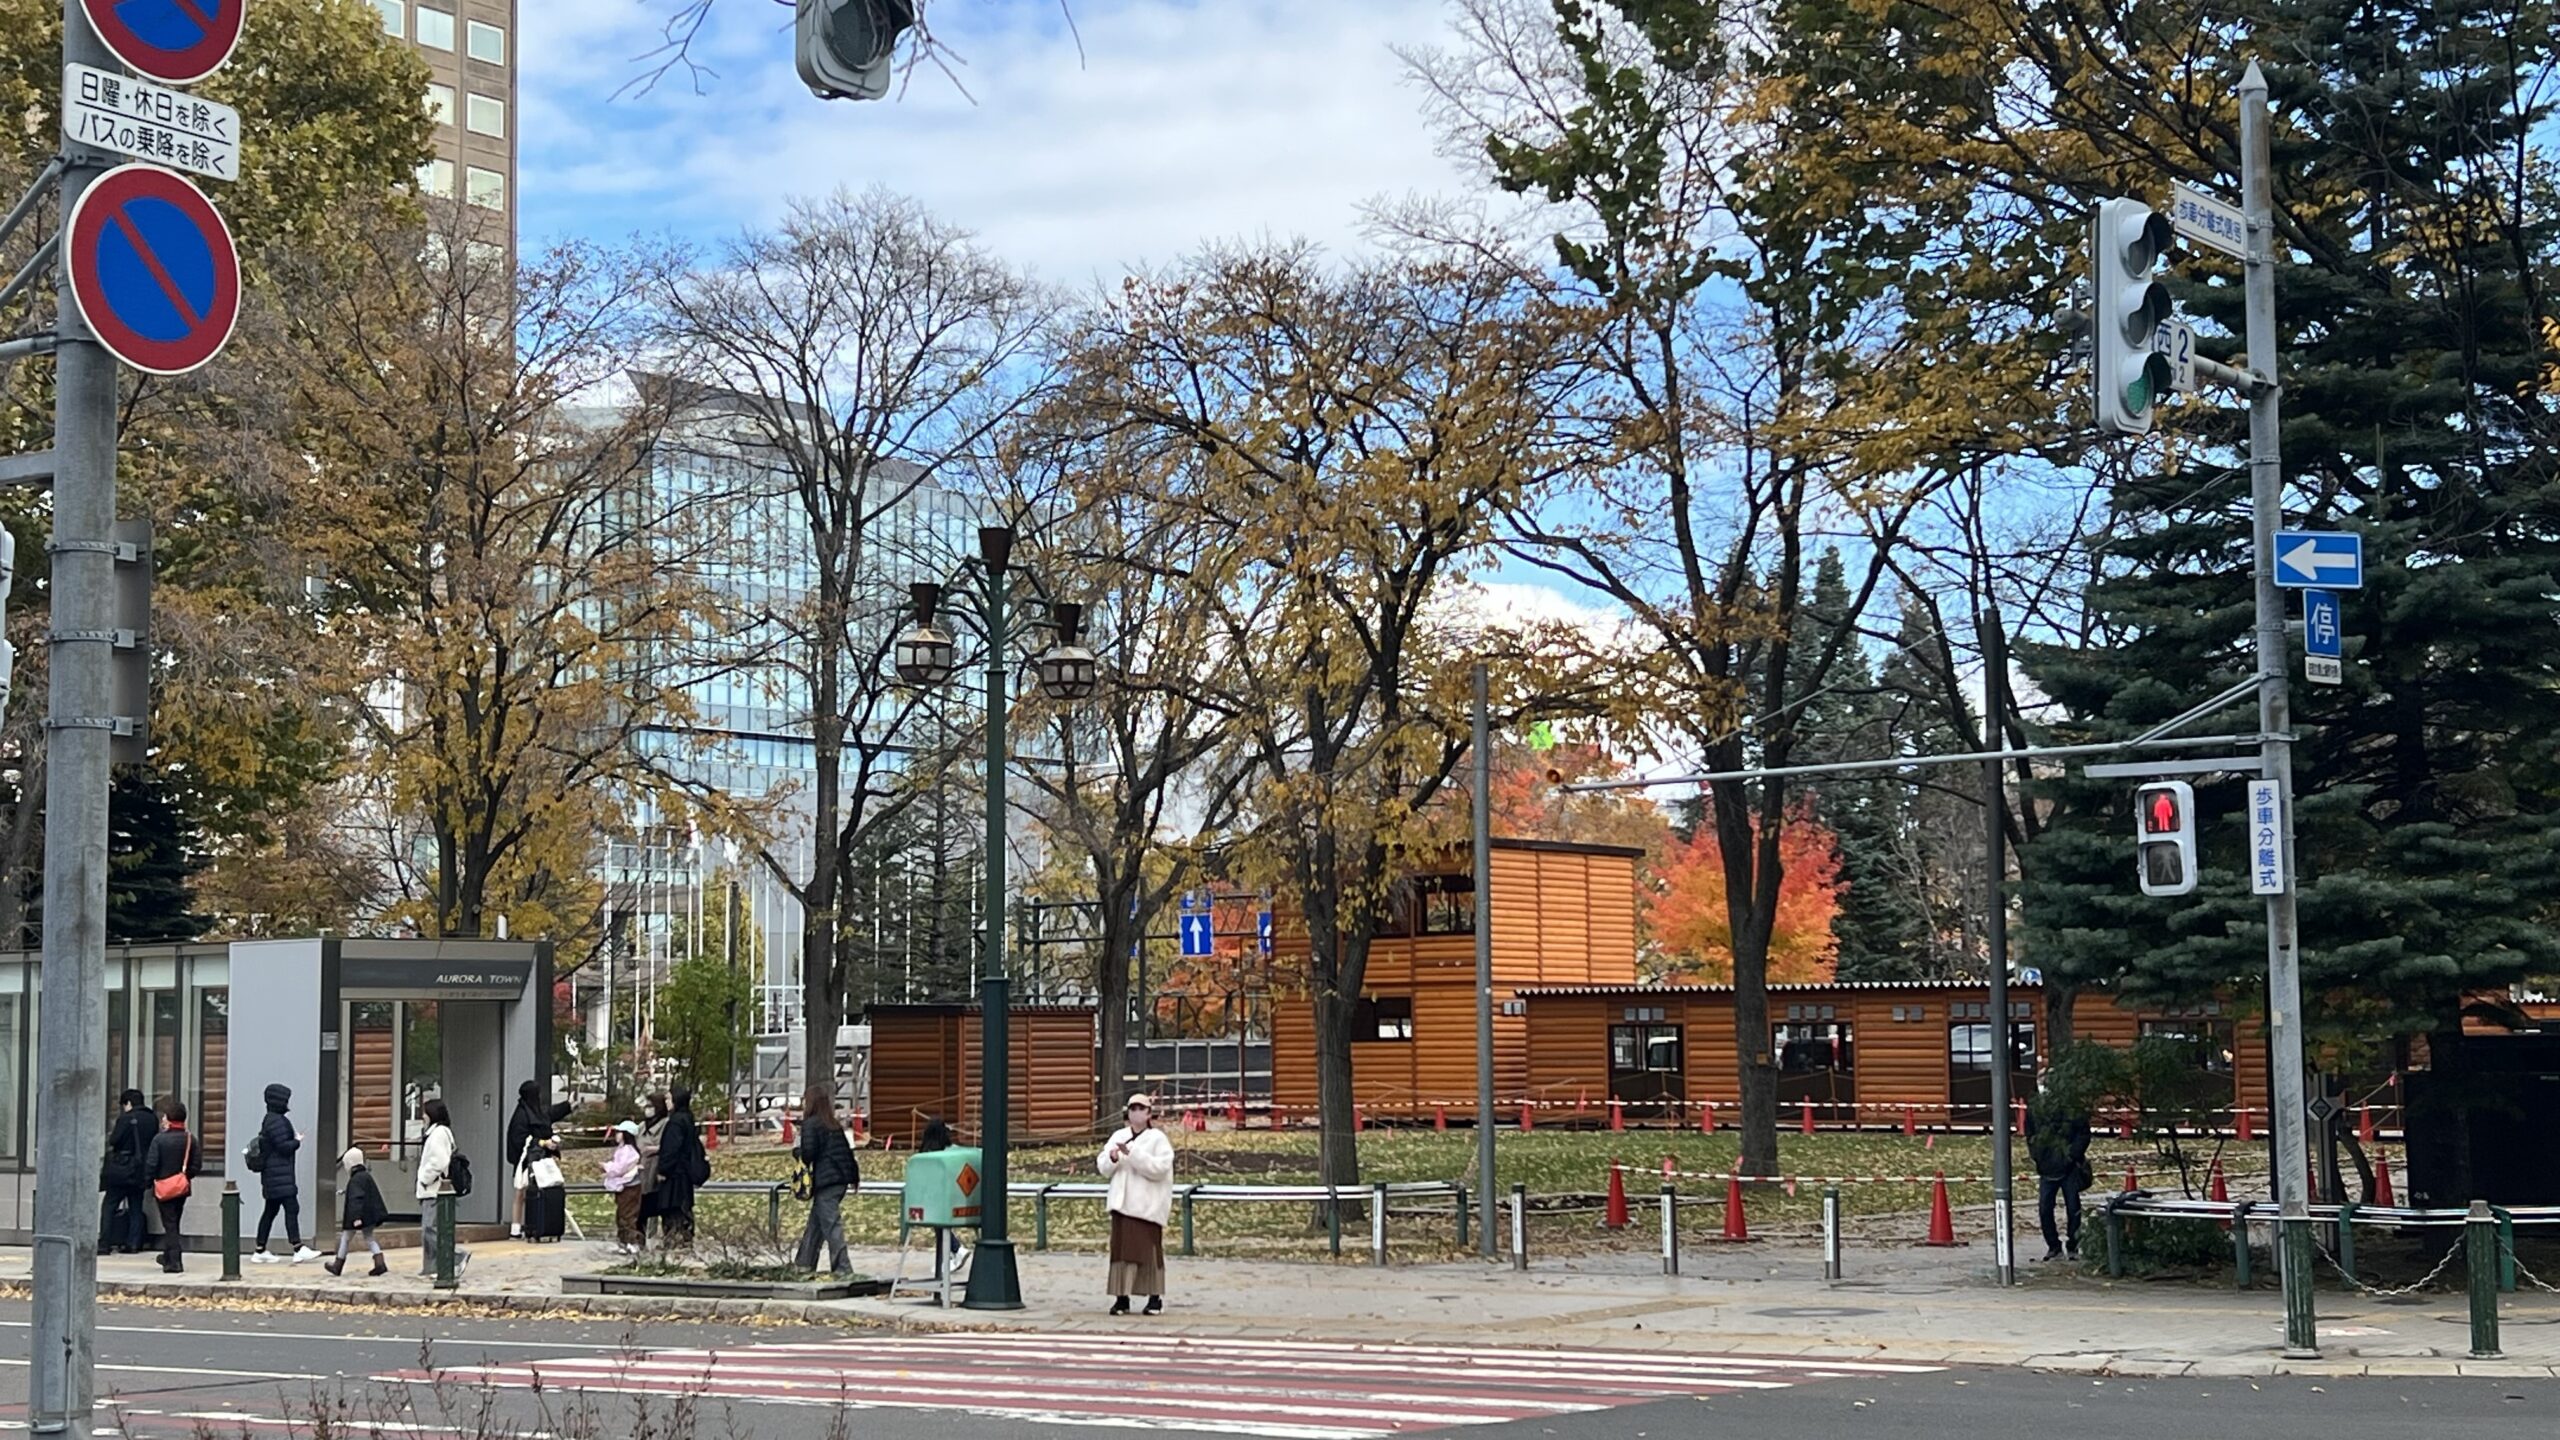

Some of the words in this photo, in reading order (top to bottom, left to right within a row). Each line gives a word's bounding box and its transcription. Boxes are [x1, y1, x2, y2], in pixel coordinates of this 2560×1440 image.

[81, 71, 227, 138] 日曜・休日を除く
[79, 112, 225, 175] バスの乗降を除く
[2179, 198, 2242, 246] 歩車分離式信号
[2310, 601, 2336, 645] 停
[2256, 786, 2277, 889] 歩車分離式
[435, 974, 483, 984] AURORA
[489, 974, 522, 985] TOWN
